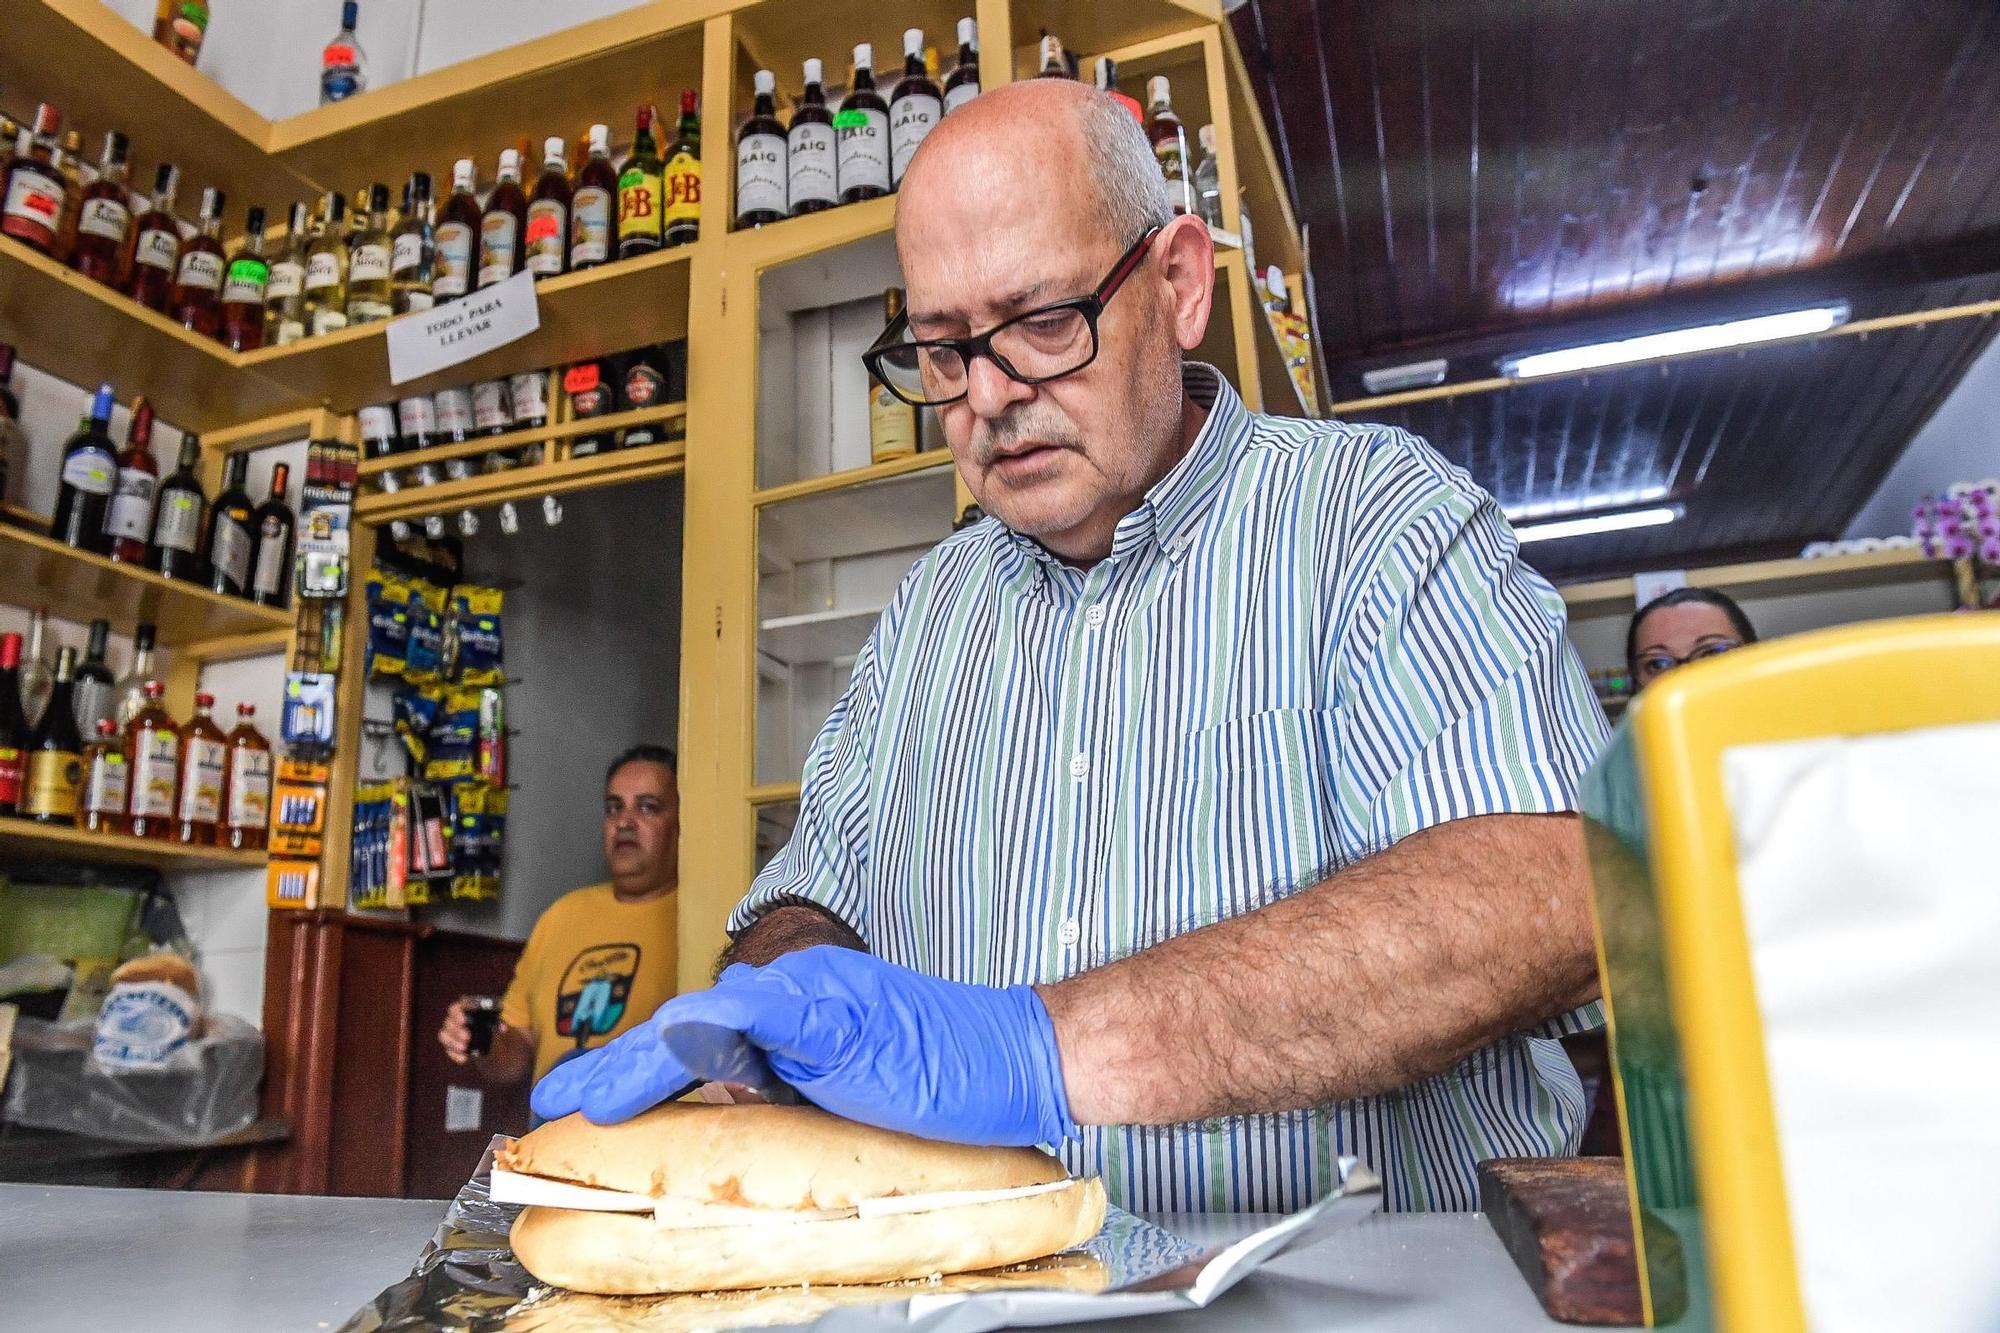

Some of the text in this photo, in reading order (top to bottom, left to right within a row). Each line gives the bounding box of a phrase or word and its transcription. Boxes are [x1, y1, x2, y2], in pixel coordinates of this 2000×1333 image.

[424, 297, 503, 335] TODO PARA
[439, 319, 493, 347] LLEVAR
